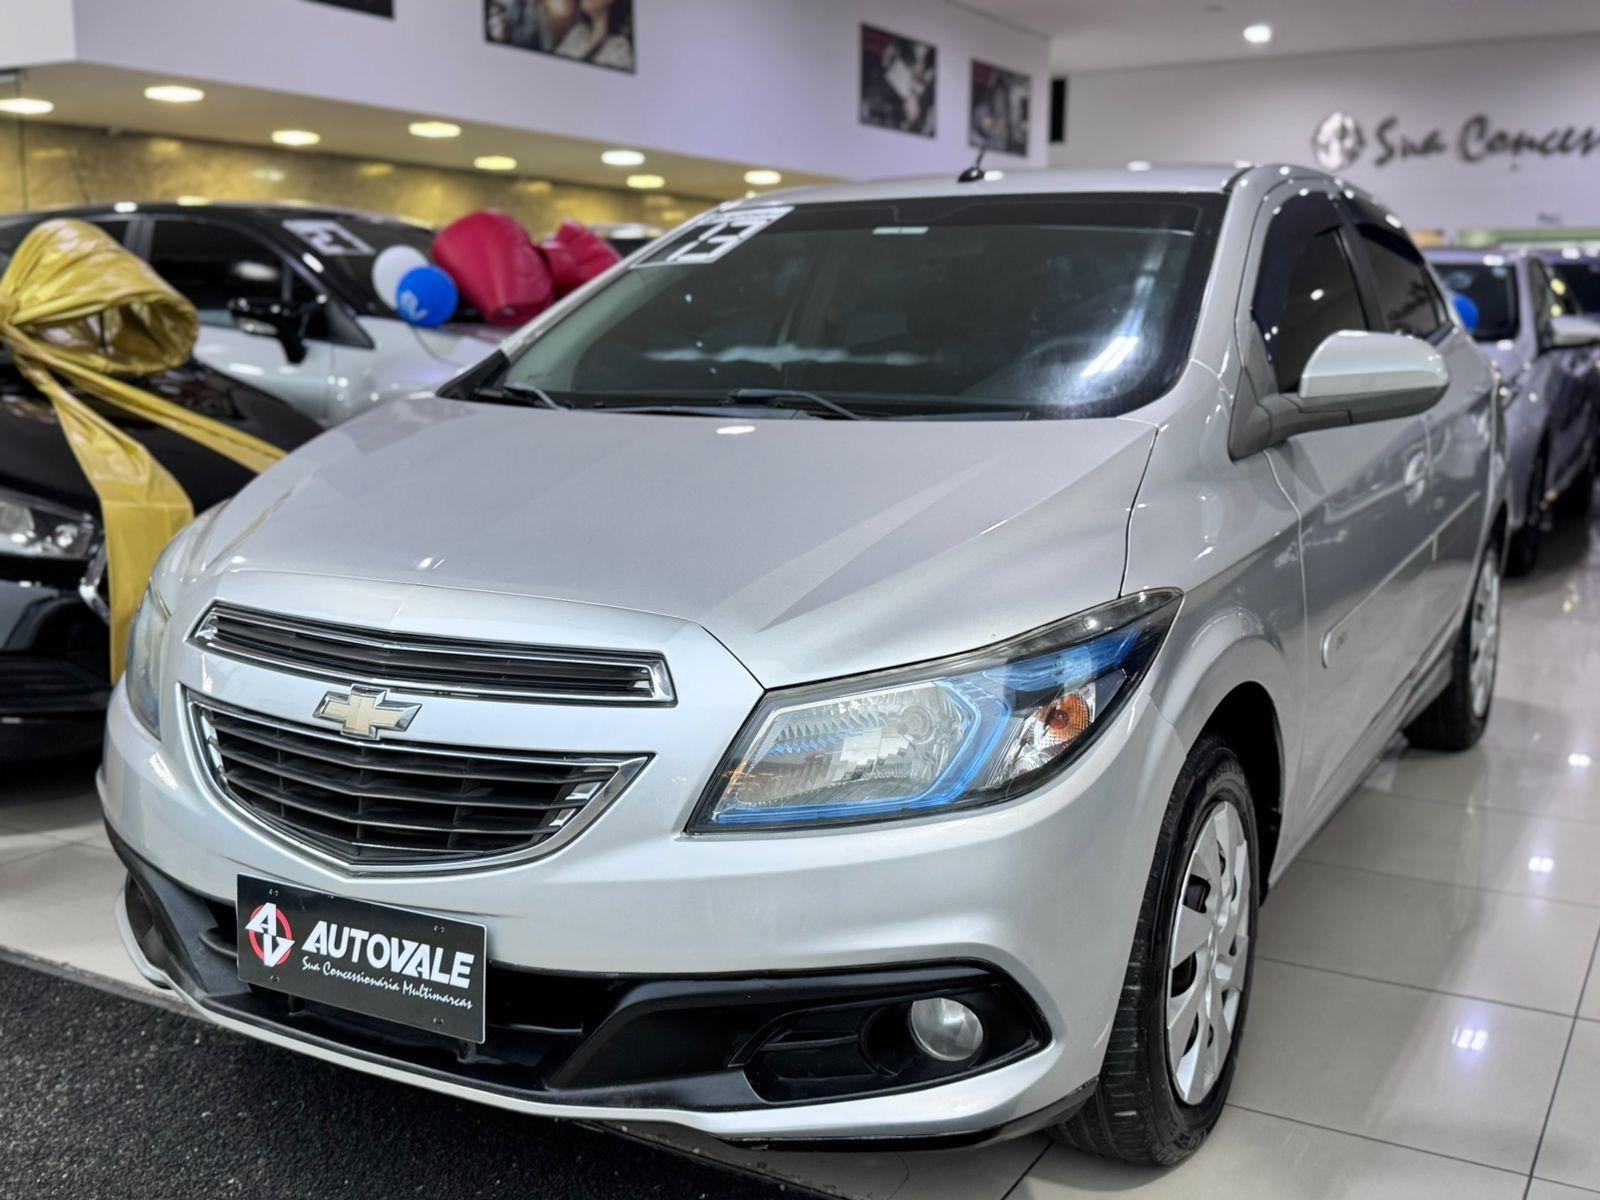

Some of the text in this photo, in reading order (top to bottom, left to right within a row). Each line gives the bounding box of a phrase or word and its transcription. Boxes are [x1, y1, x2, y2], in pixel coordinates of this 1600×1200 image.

[301, 920, 475, 989] AUTOVALE
[302, 955, 473, 1011] Sua Concessionária Multimarcas
